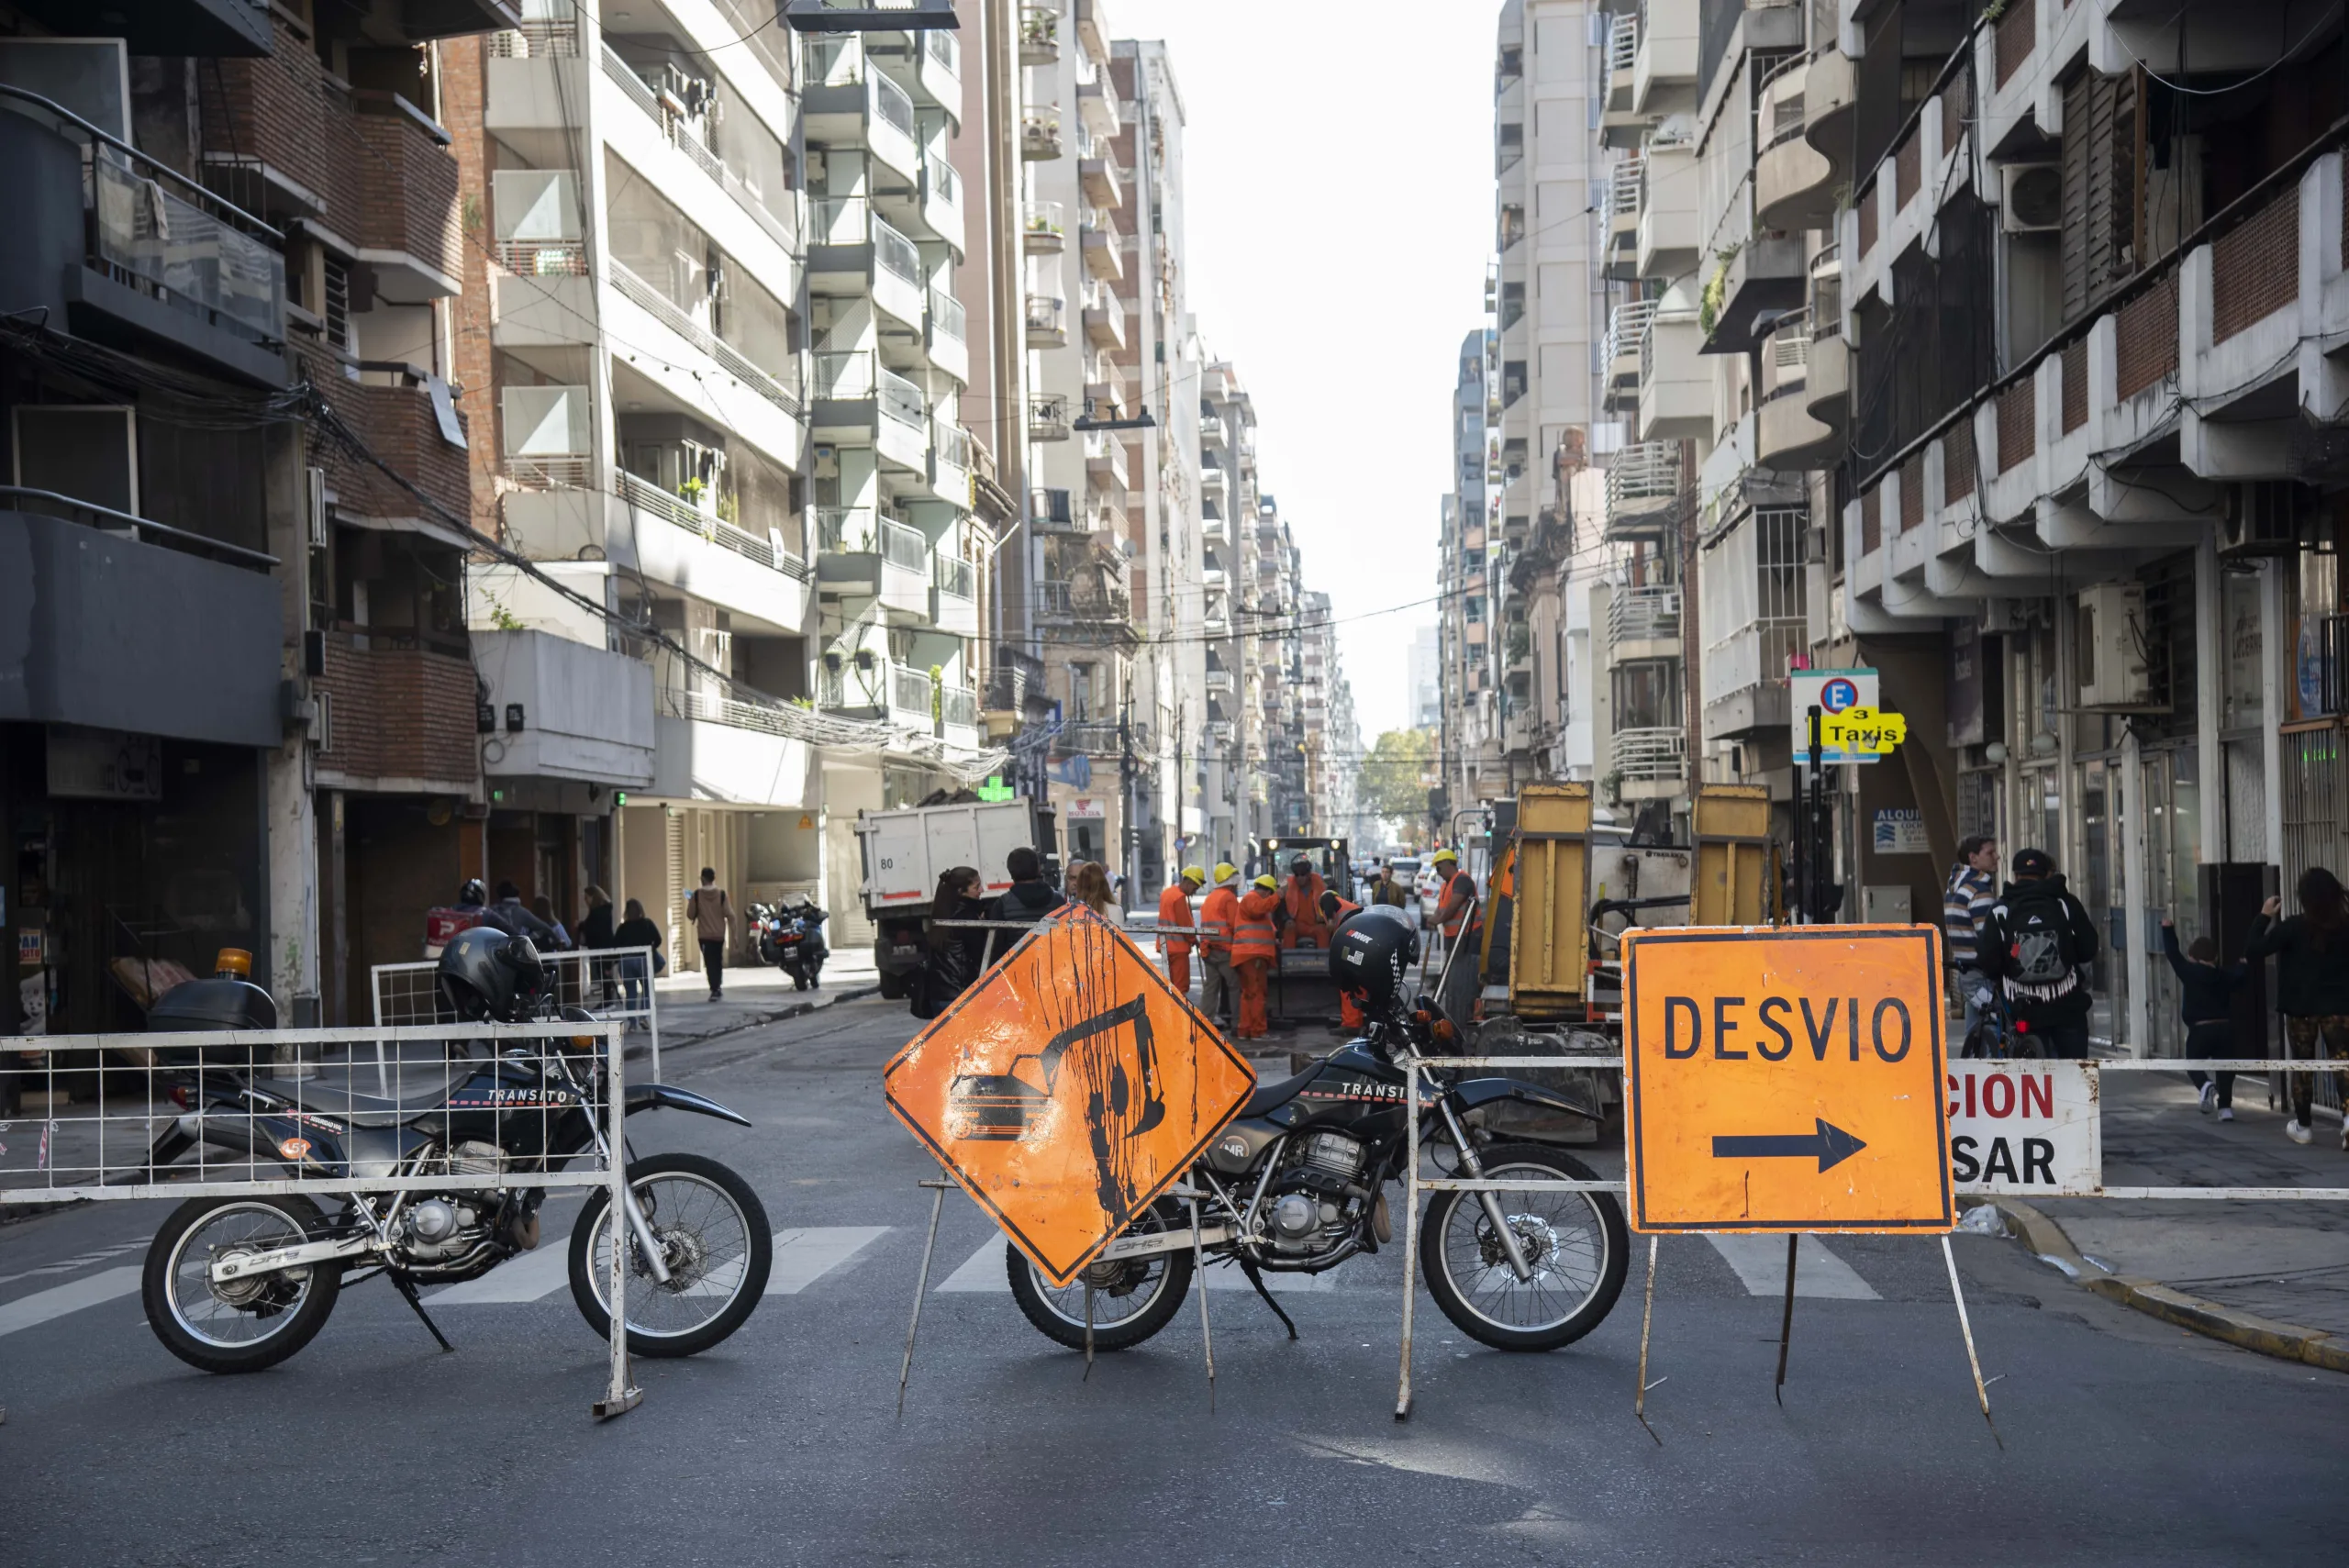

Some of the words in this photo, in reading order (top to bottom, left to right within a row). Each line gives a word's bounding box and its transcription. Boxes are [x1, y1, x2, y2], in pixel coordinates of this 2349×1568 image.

[1831, 684, 1847, 708] E
[1854, 710, 1869, 720] 3
[1829, 726, 1898, 741] Taxis
[881, 858, 893, 870] 80
[1664, 996, 1912, 1063] DESVIO
[488, 1089, 567, 1102] TRANSITO
[1342, 1083, 1426, 1101] TRANSI
[1951, 1136, 2057, 1184] SAR
